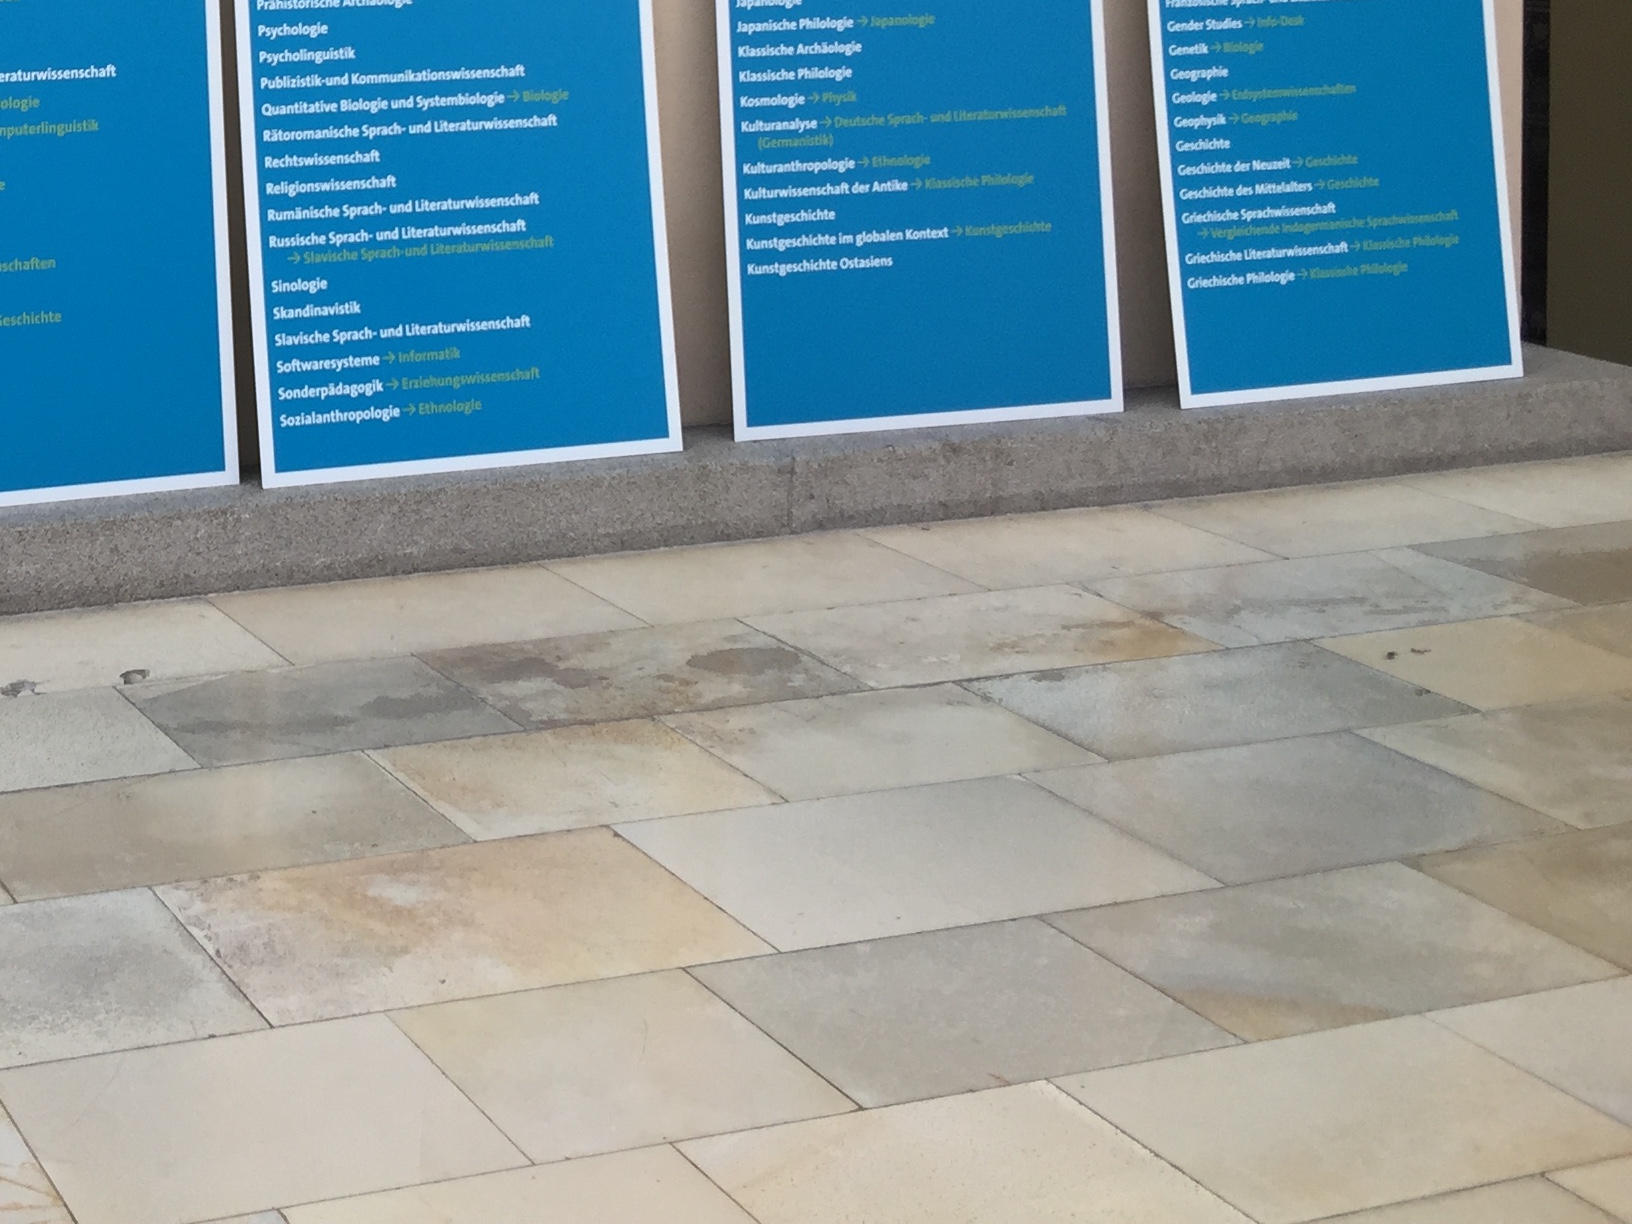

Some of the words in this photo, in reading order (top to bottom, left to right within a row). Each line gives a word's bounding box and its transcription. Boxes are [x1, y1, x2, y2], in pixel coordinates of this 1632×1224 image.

[257, 21, 328, 40] Psychologie
[258, 46, 356, 66] Psycholinguistik
[737, 43, 794, 57] Klassische
[795, 40, 862, 56] Archäologie
[1169, 65, 1229, 82] Geographie
[1175, 137, 1230, 152] Geschichte
[264, 149, 380, 168] Rechtswissenschaft
[742, 157, 856, 174] Kulturanthropologie
[265, 174, 396, 197] Religionswissenschaft
[744, 208, 836, 226] Kunstgeschichte
[1181, 209, 1239, 224] Griechische
[1239, 201, 1336, 222] Sprachwissenschaft
[747, 258, 838, 276] Kunstgeschichte
[839, 255, 893, 269] Ostasiens
[271, 276, 328, 294] Sinologie
[272, 300, 361, 320] Skandinavistik
[276, 355, 380, 373] Softwaresysteme
[279, 404, 400, 427] Sozialanthropologie
